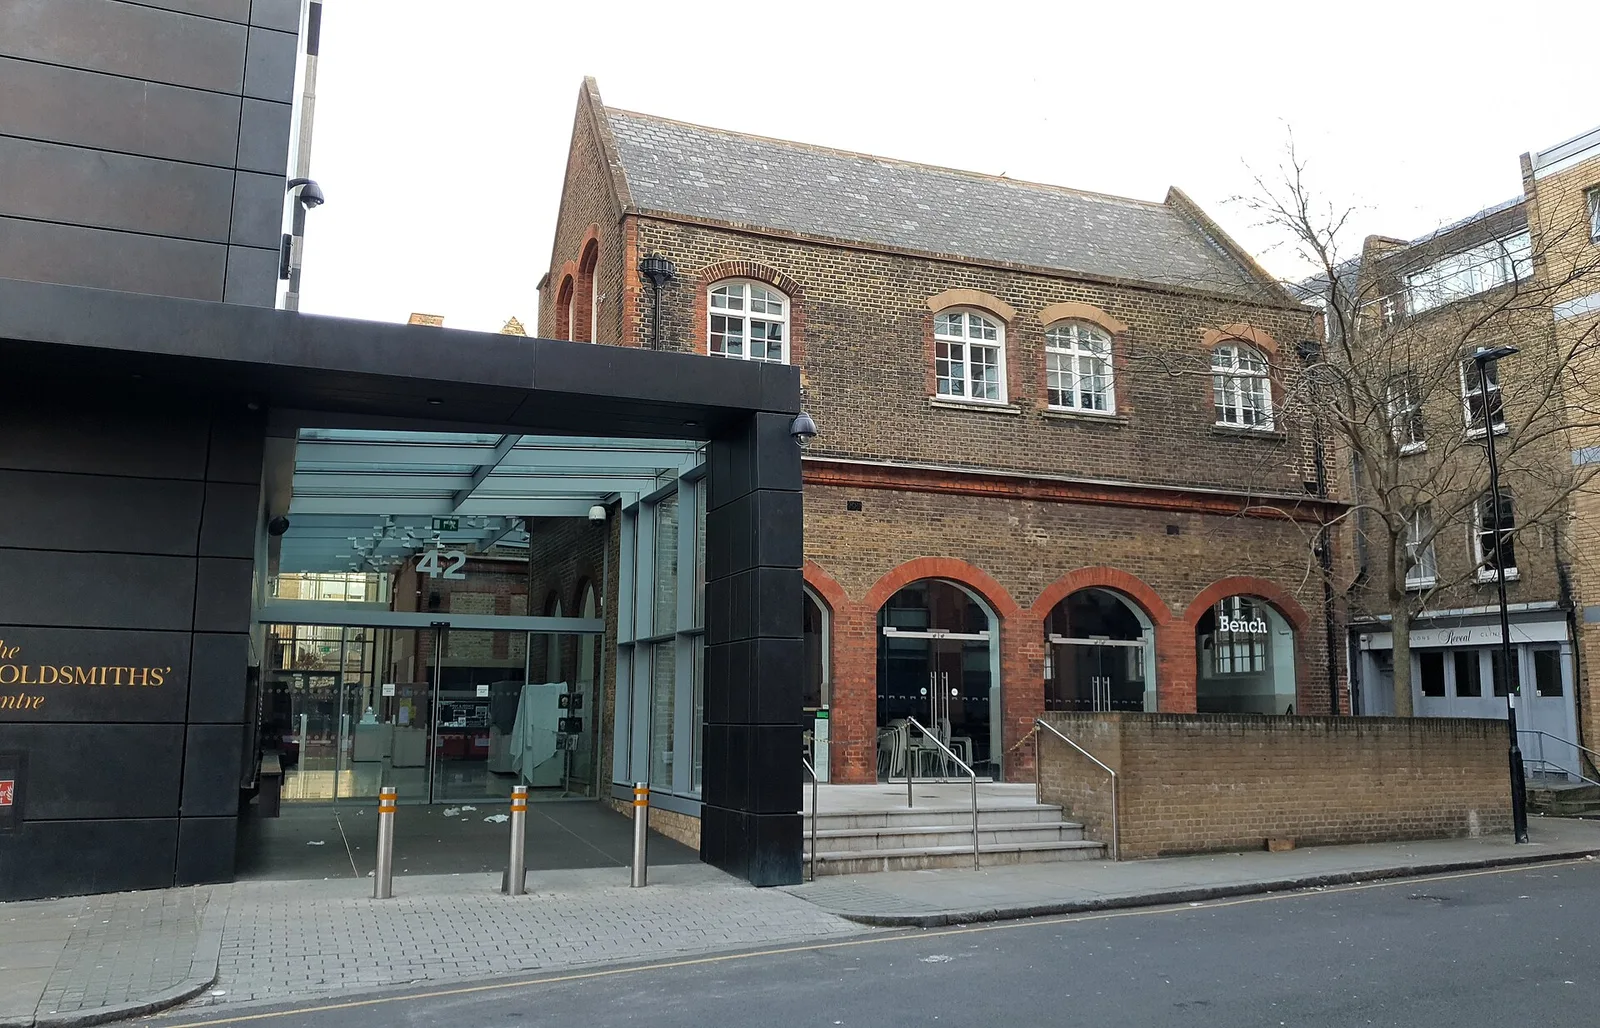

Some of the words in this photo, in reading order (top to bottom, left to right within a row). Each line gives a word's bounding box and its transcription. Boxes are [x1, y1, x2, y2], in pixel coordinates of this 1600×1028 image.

[415, 549, 466, 580] 42
[1219, 615, 1268, 633] Bench
[0, 639, 20, 659] he
[0, 664, 171, 687] OLDSMITHS’
[0, 692, 45, 709] ntre
